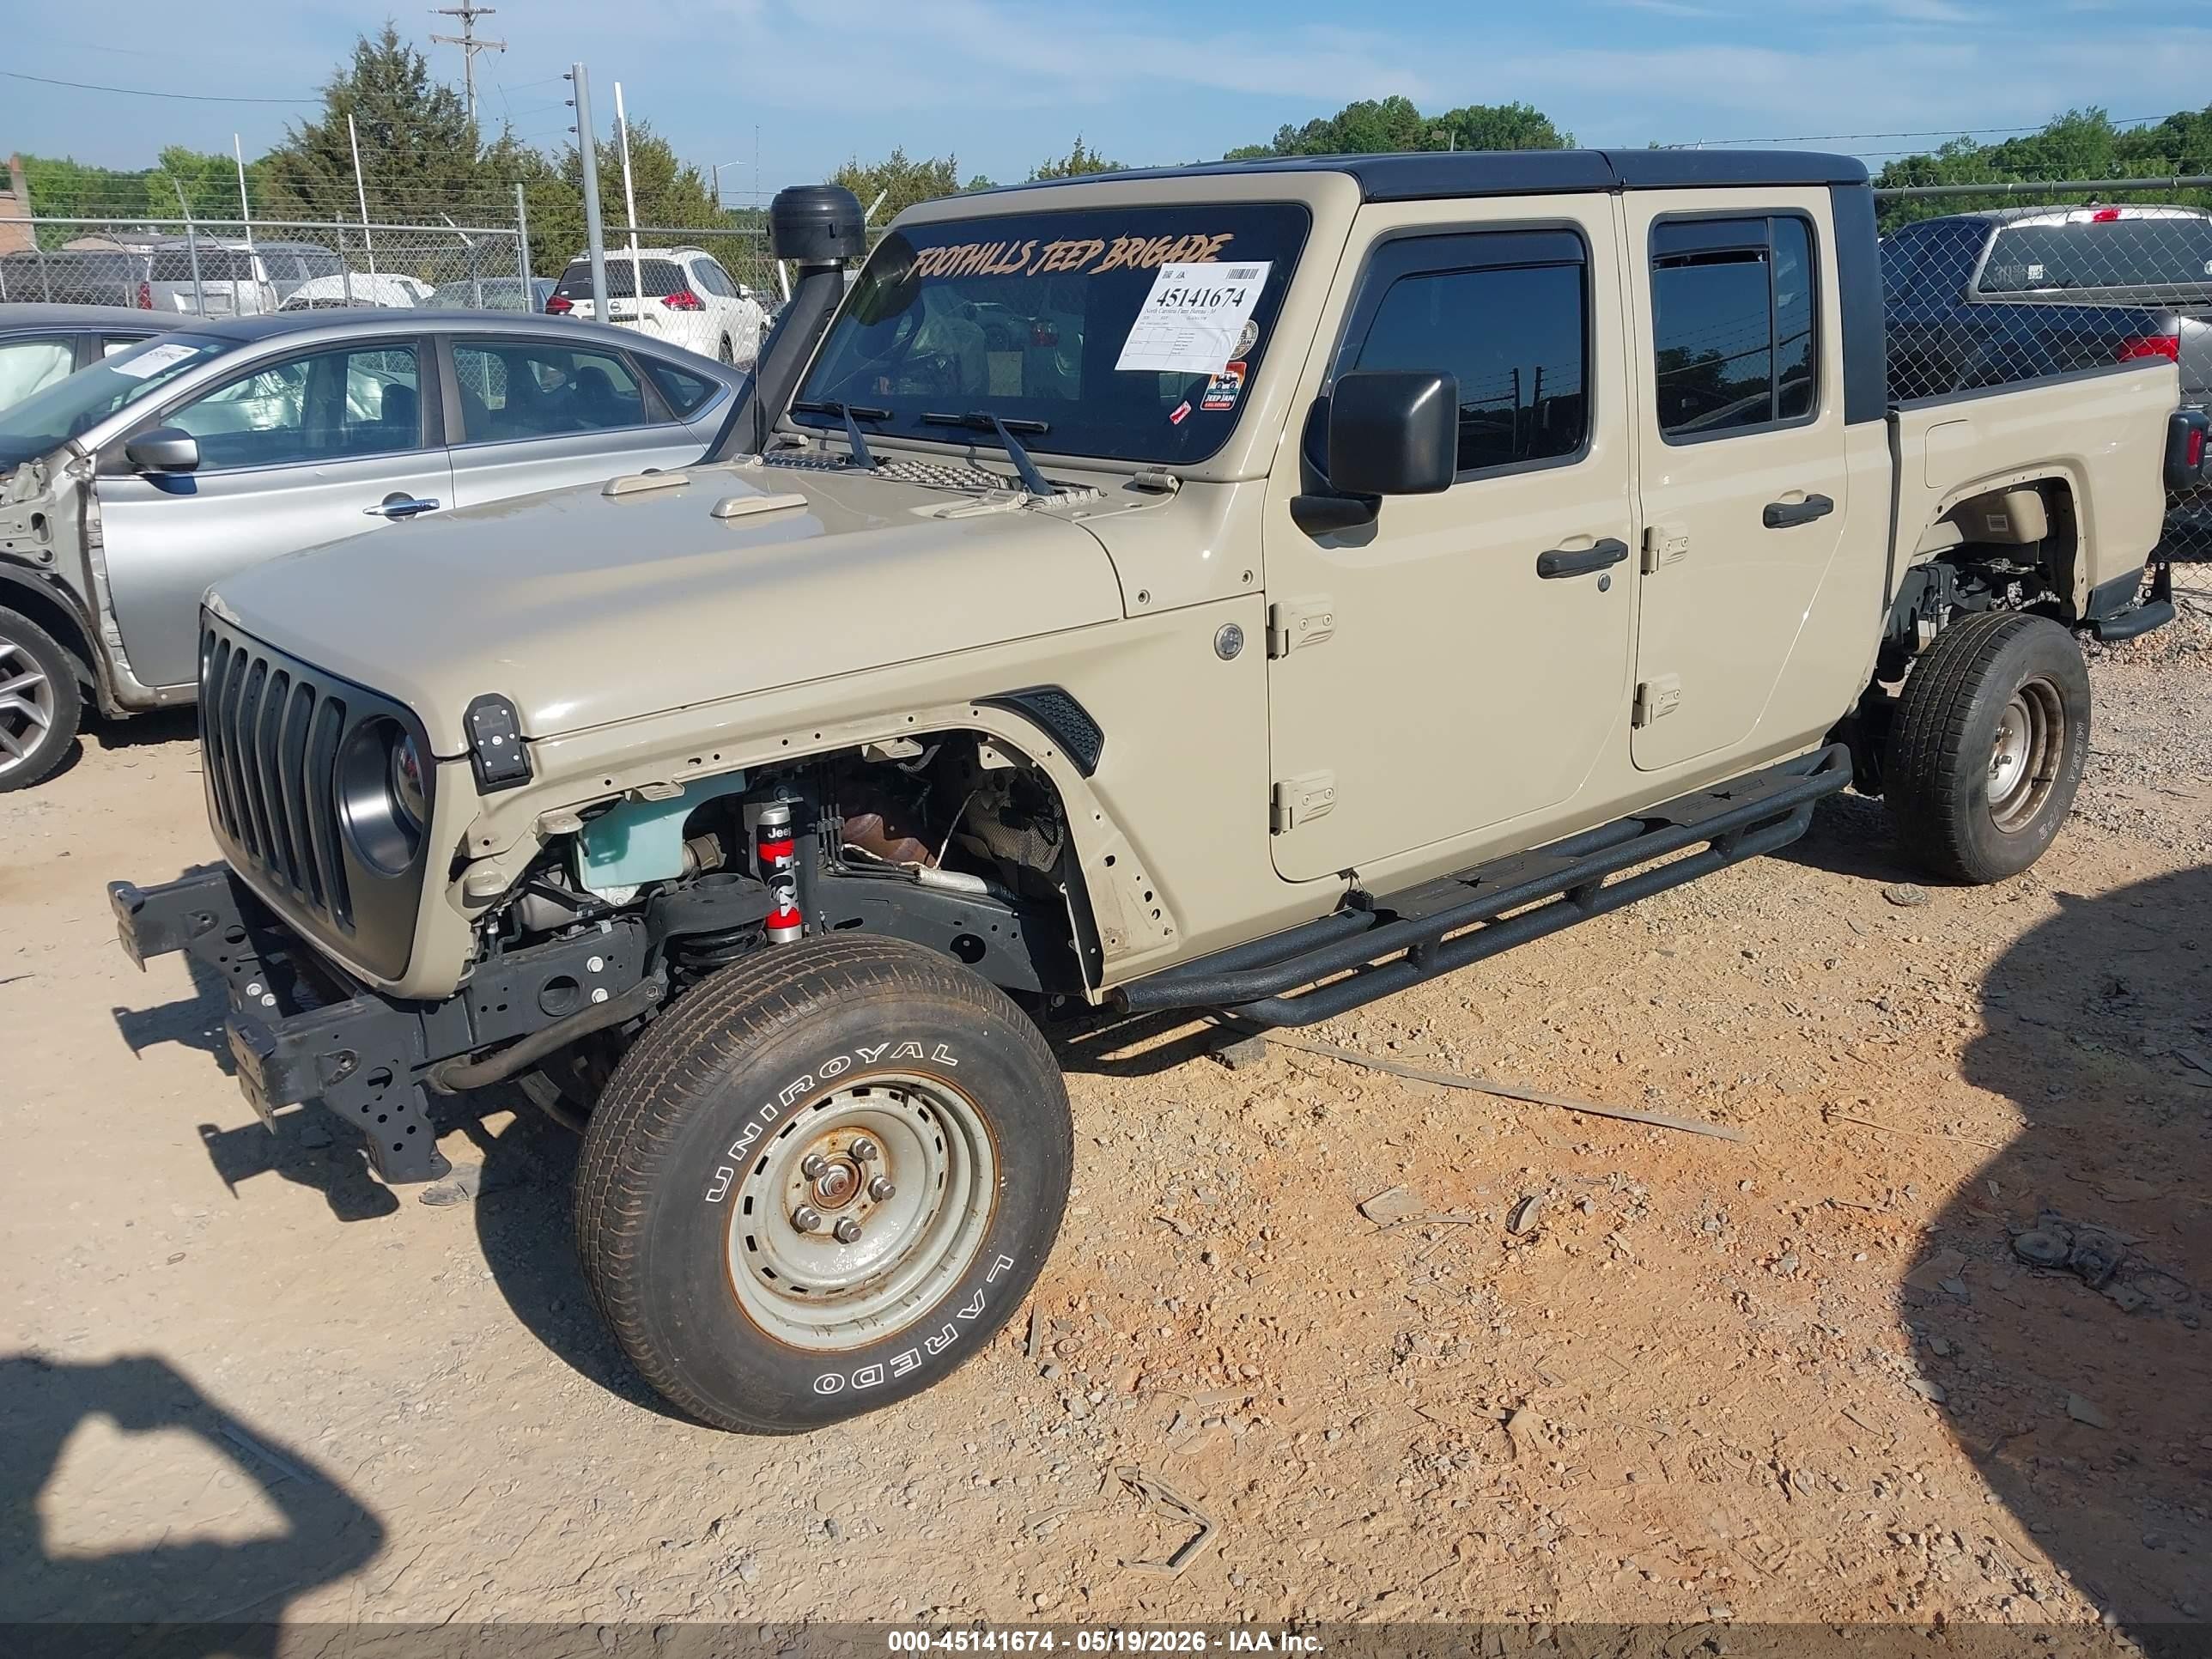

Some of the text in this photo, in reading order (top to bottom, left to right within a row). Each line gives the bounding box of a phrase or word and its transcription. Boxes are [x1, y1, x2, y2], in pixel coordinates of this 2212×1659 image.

[901, 230, 1235, 285] FOOTHILLS JEEP BRIGADE
[1157, 288, 1248, 307] 45141674
[1219, 394, 1235, 403] JAM
[767, 853, 799, 917] FOX
[705, 1041, 959, 1203] UNIROYAL
[812, 1254, 1015, 1395] LAREDO
